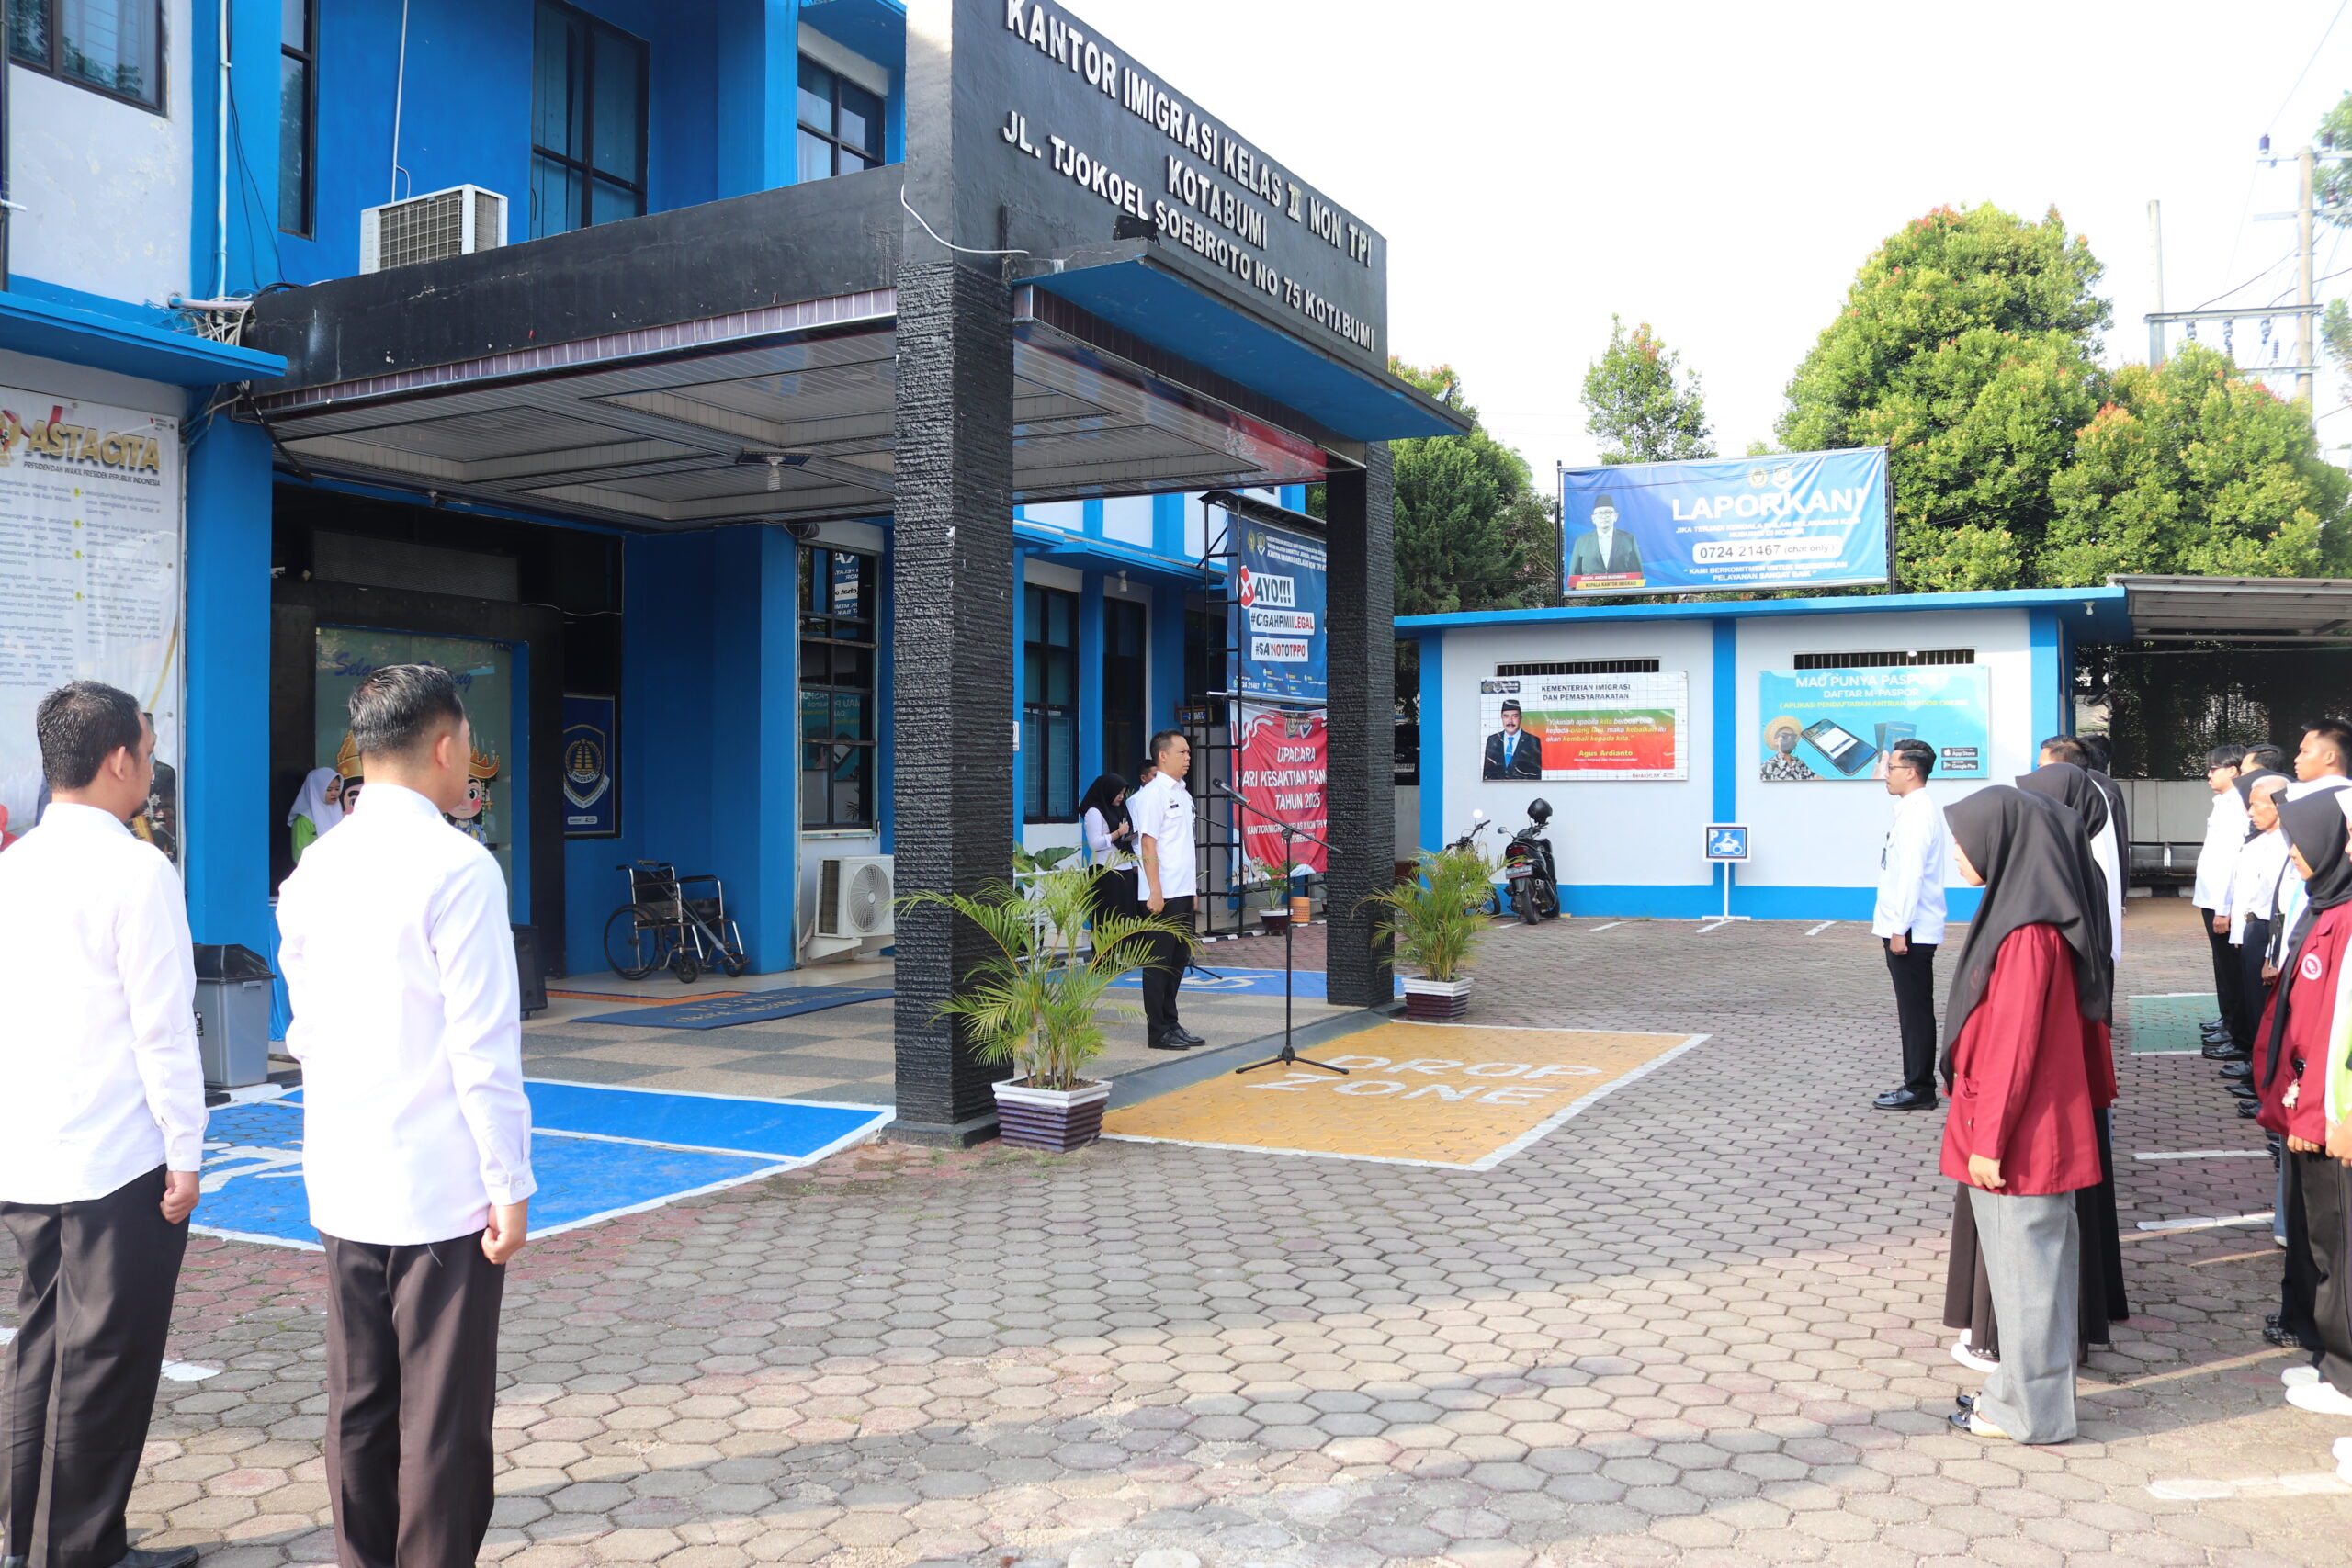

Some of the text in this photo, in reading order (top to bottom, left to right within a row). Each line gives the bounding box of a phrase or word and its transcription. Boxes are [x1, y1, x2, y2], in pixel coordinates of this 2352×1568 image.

[1006, 0, 1372, 267] KANTOR IMIGRASI KELAS II NON TPI
[1168, 154, 1268, 250] KOTABUMI
[1002, 110, 1374, 353] JL. TJOKOEL SOEBROTO NO 75 KOTABUMI
[27, 419, 161, 475] ASTACITA
[24, 461, 160, 487] PRESIDEN DAN WAKIL PRESIDEN REPUBLIK INDONESIA
[1700, 547, 1734, 559] 0724
[1738, 544, 1781, 557] 21467
[1710, 565, 1765, 574] BERKOMITMEN
[1713, 572, 1758, 581] PELAYANAN
[1255, 577, 1291, 604] AYO!!!
[1542, 684, 1594, 693] KEMENTERIAN
[1796, 676, 1826, 688] MAU
[1830, 675, 1877, 687] PUNYA
[1560, 693, 1629, 701] PEMASYARAKATAN
[1824, 687, 1919, 699] DAFTAR M-PASPOR
[1589, 735, 1614, 743] kepada
[1277, 747, 1315, 763] UPACARA
[1260, 770, 1306, 787] KESAKTIAN
[1275, 793, 1320, 810] TAHUN 2025
[1709, 829, 1719, 842] P
[1323, 1055, 1603, 1081] DROP
[1245, 1072, 1559, 1107] ZONE
